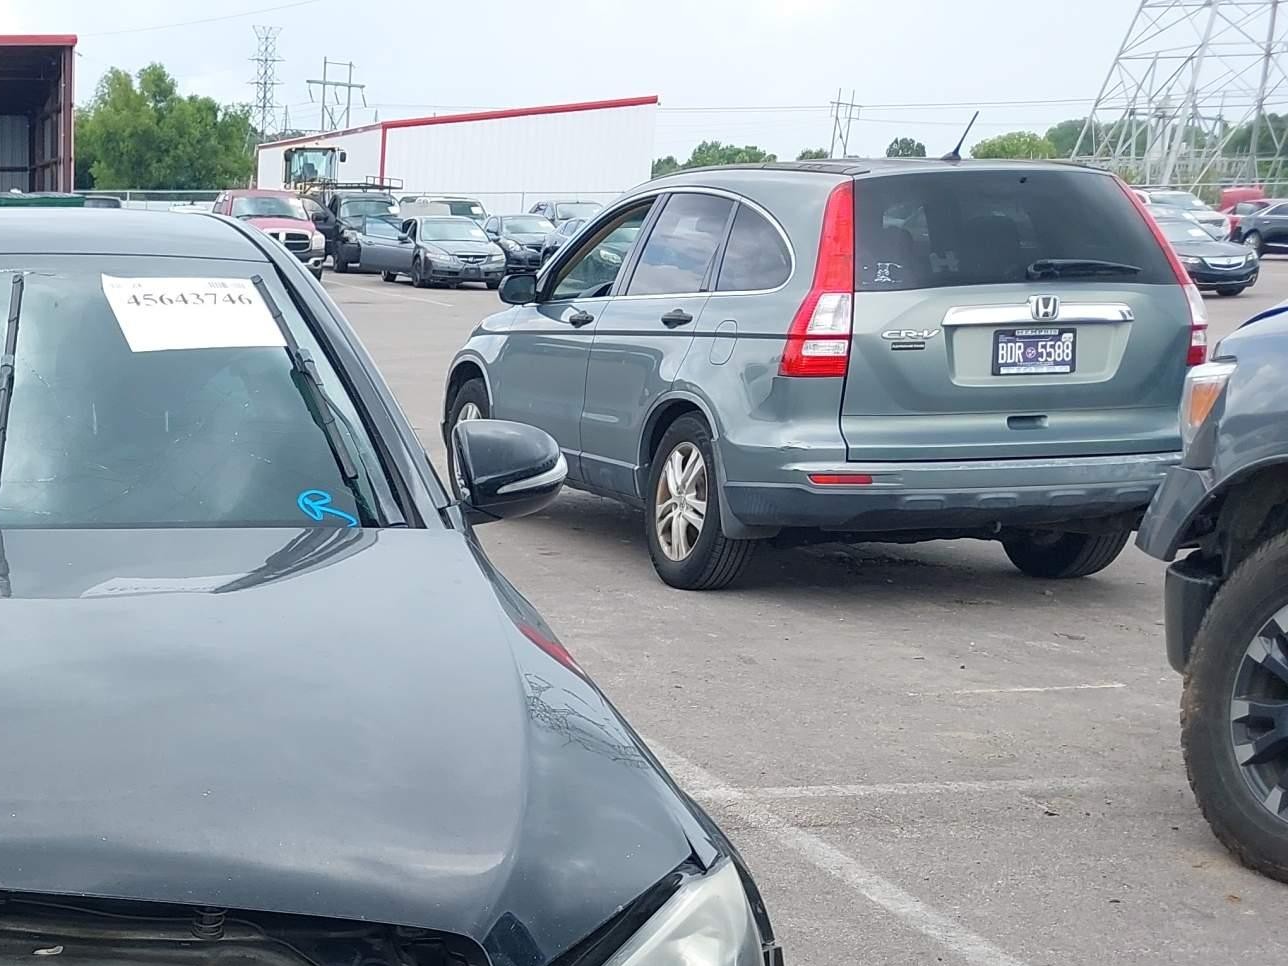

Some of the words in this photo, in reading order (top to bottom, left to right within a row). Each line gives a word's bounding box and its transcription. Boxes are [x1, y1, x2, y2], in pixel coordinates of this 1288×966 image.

[125, 291, 254, 308] 45643746
[880, 328, 941, 341] CR-V
[998, 342, 1024, 363] BDR
[1037, 340, 1073, 362] 5588
